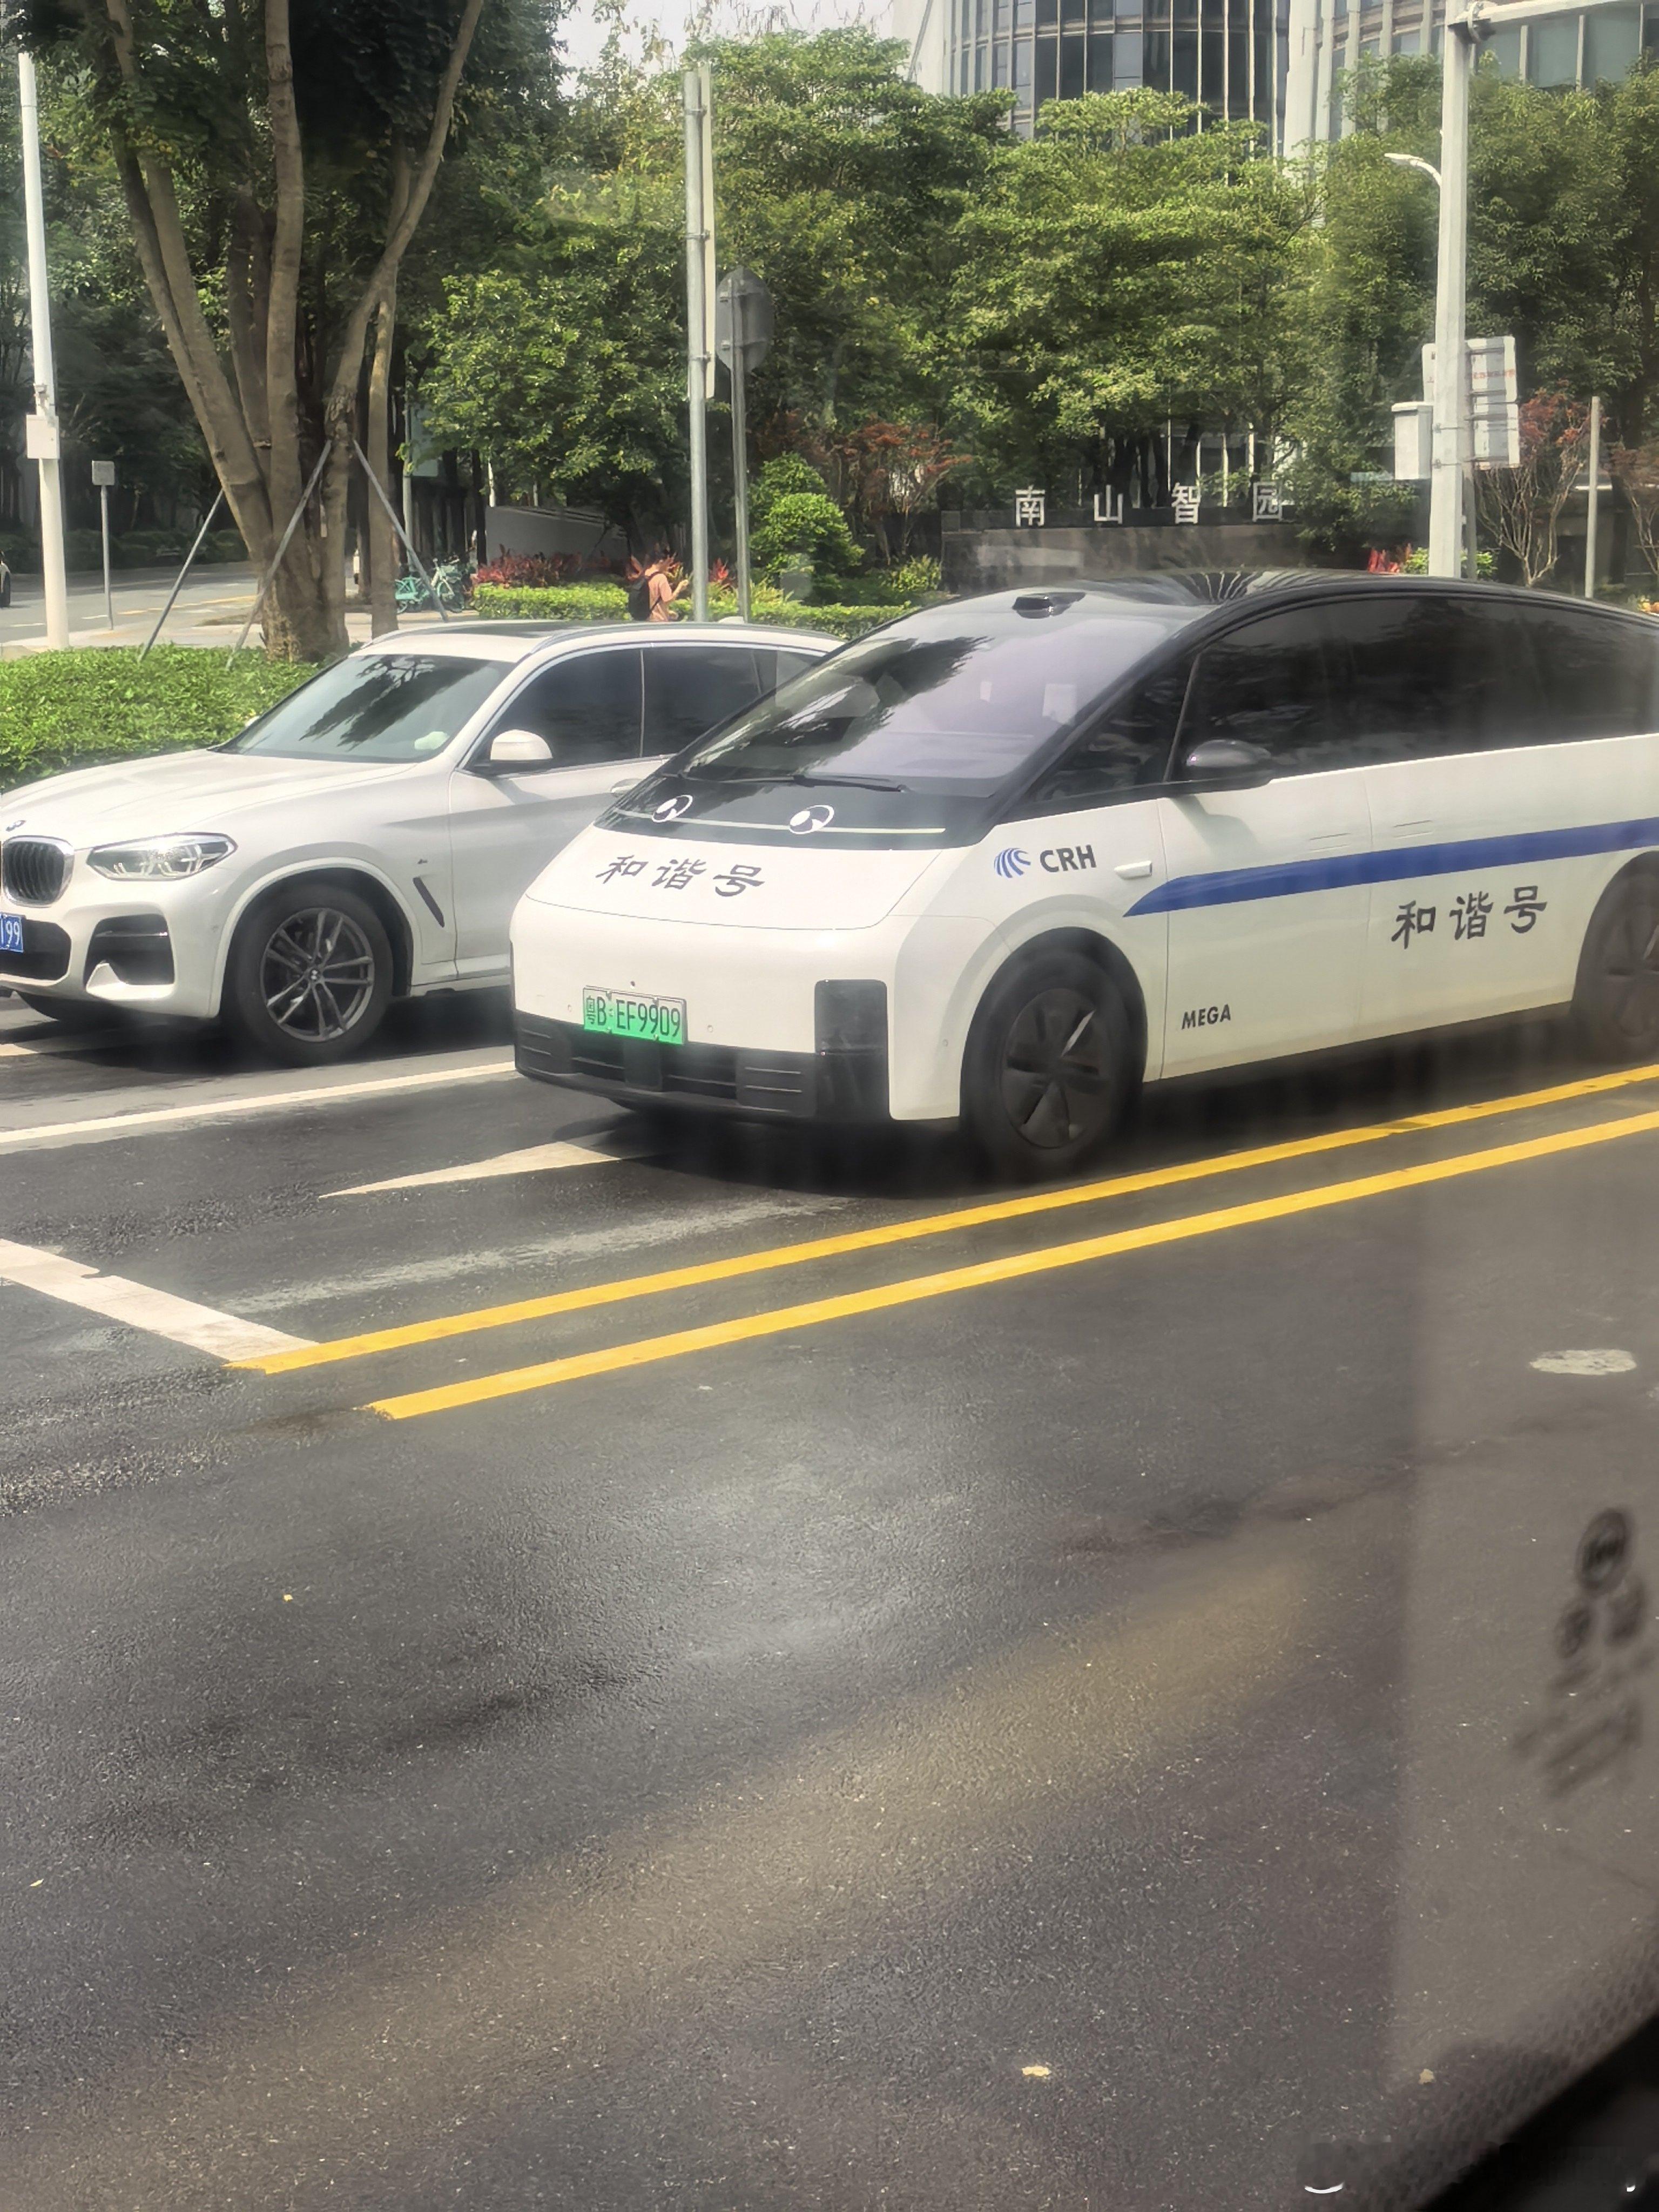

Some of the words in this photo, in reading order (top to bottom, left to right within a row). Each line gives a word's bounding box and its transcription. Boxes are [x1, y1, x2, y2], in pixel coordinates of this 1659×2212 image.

[1015, 482, 1283, 527] 南山智园
[595, 854, 765, 898] 和谐号
[1040, 845, 1096, 873] CRH
[1391, 885, 1548, 950] 和谐号
[1181, 1003, 1231, 1030] MEGA
